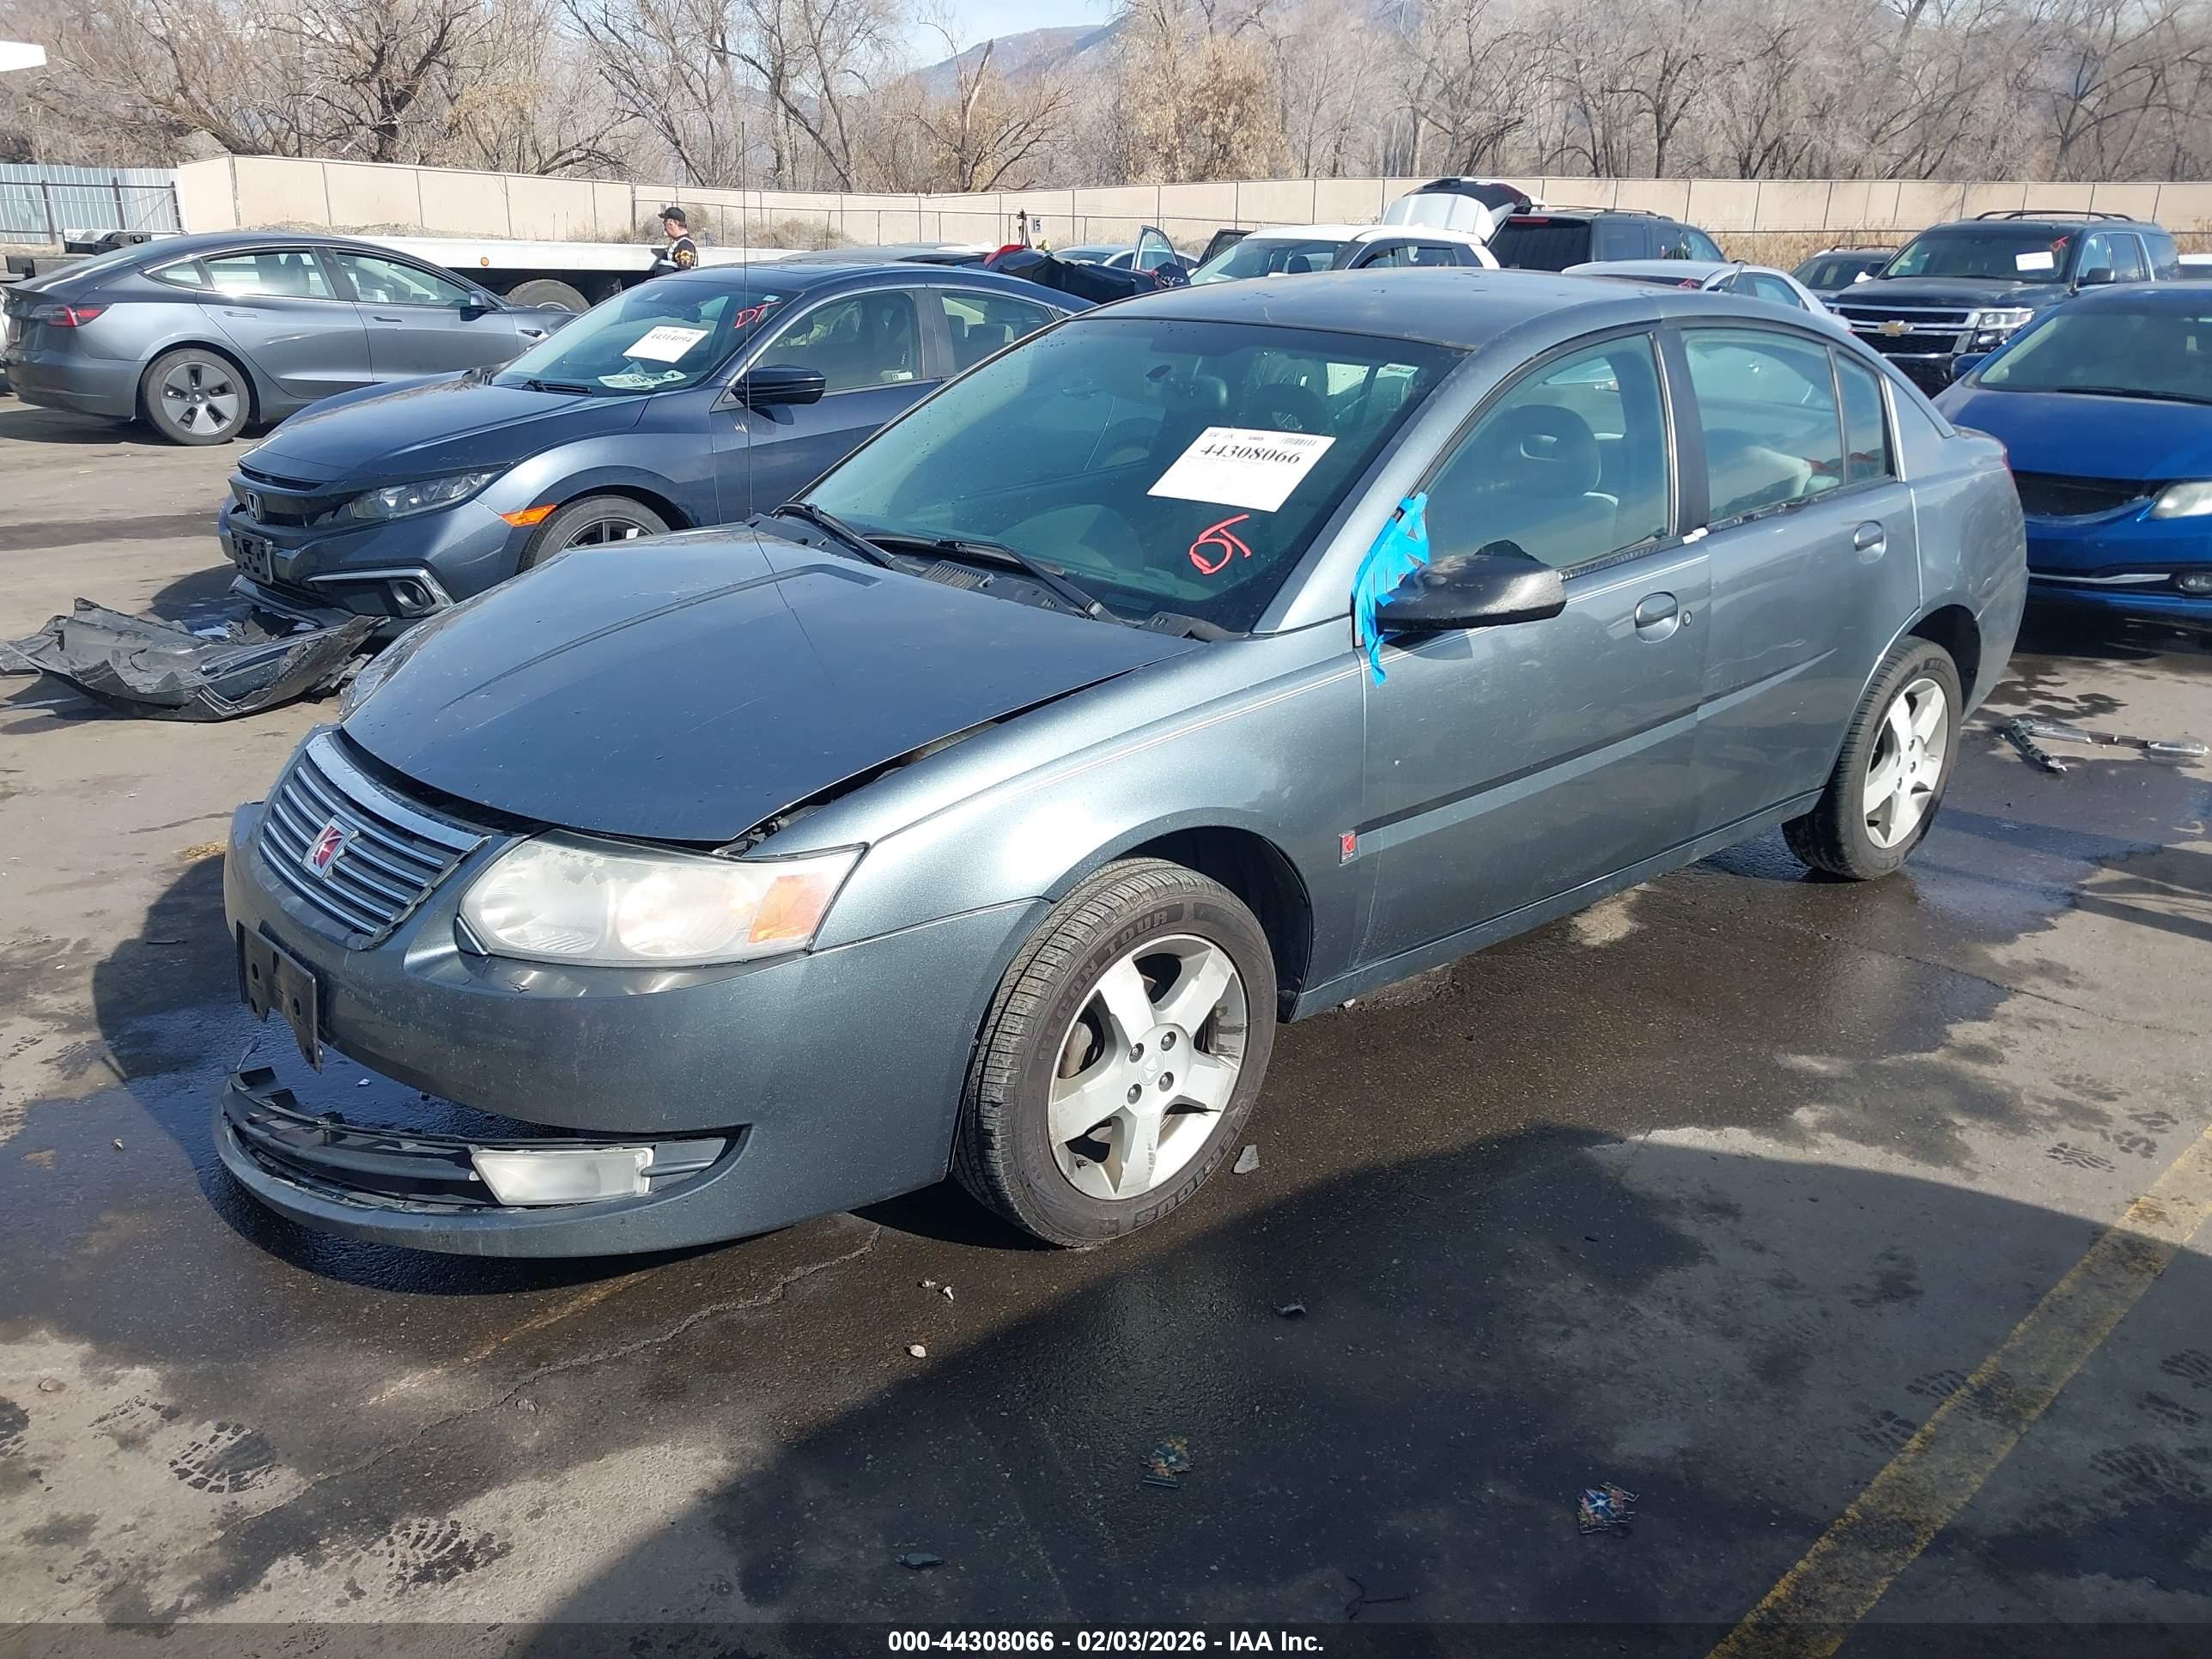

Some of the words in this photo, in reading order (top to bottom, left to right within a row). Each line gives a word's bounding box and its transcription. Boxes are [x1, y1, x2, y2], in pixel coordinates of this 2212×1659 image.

[1032, 219, 1041, 231] 15
[734, 301, 781, 329] DT
[1200, 444, 1302, 464] 44308066
[1103, 909, 1169, 957] TOUR
